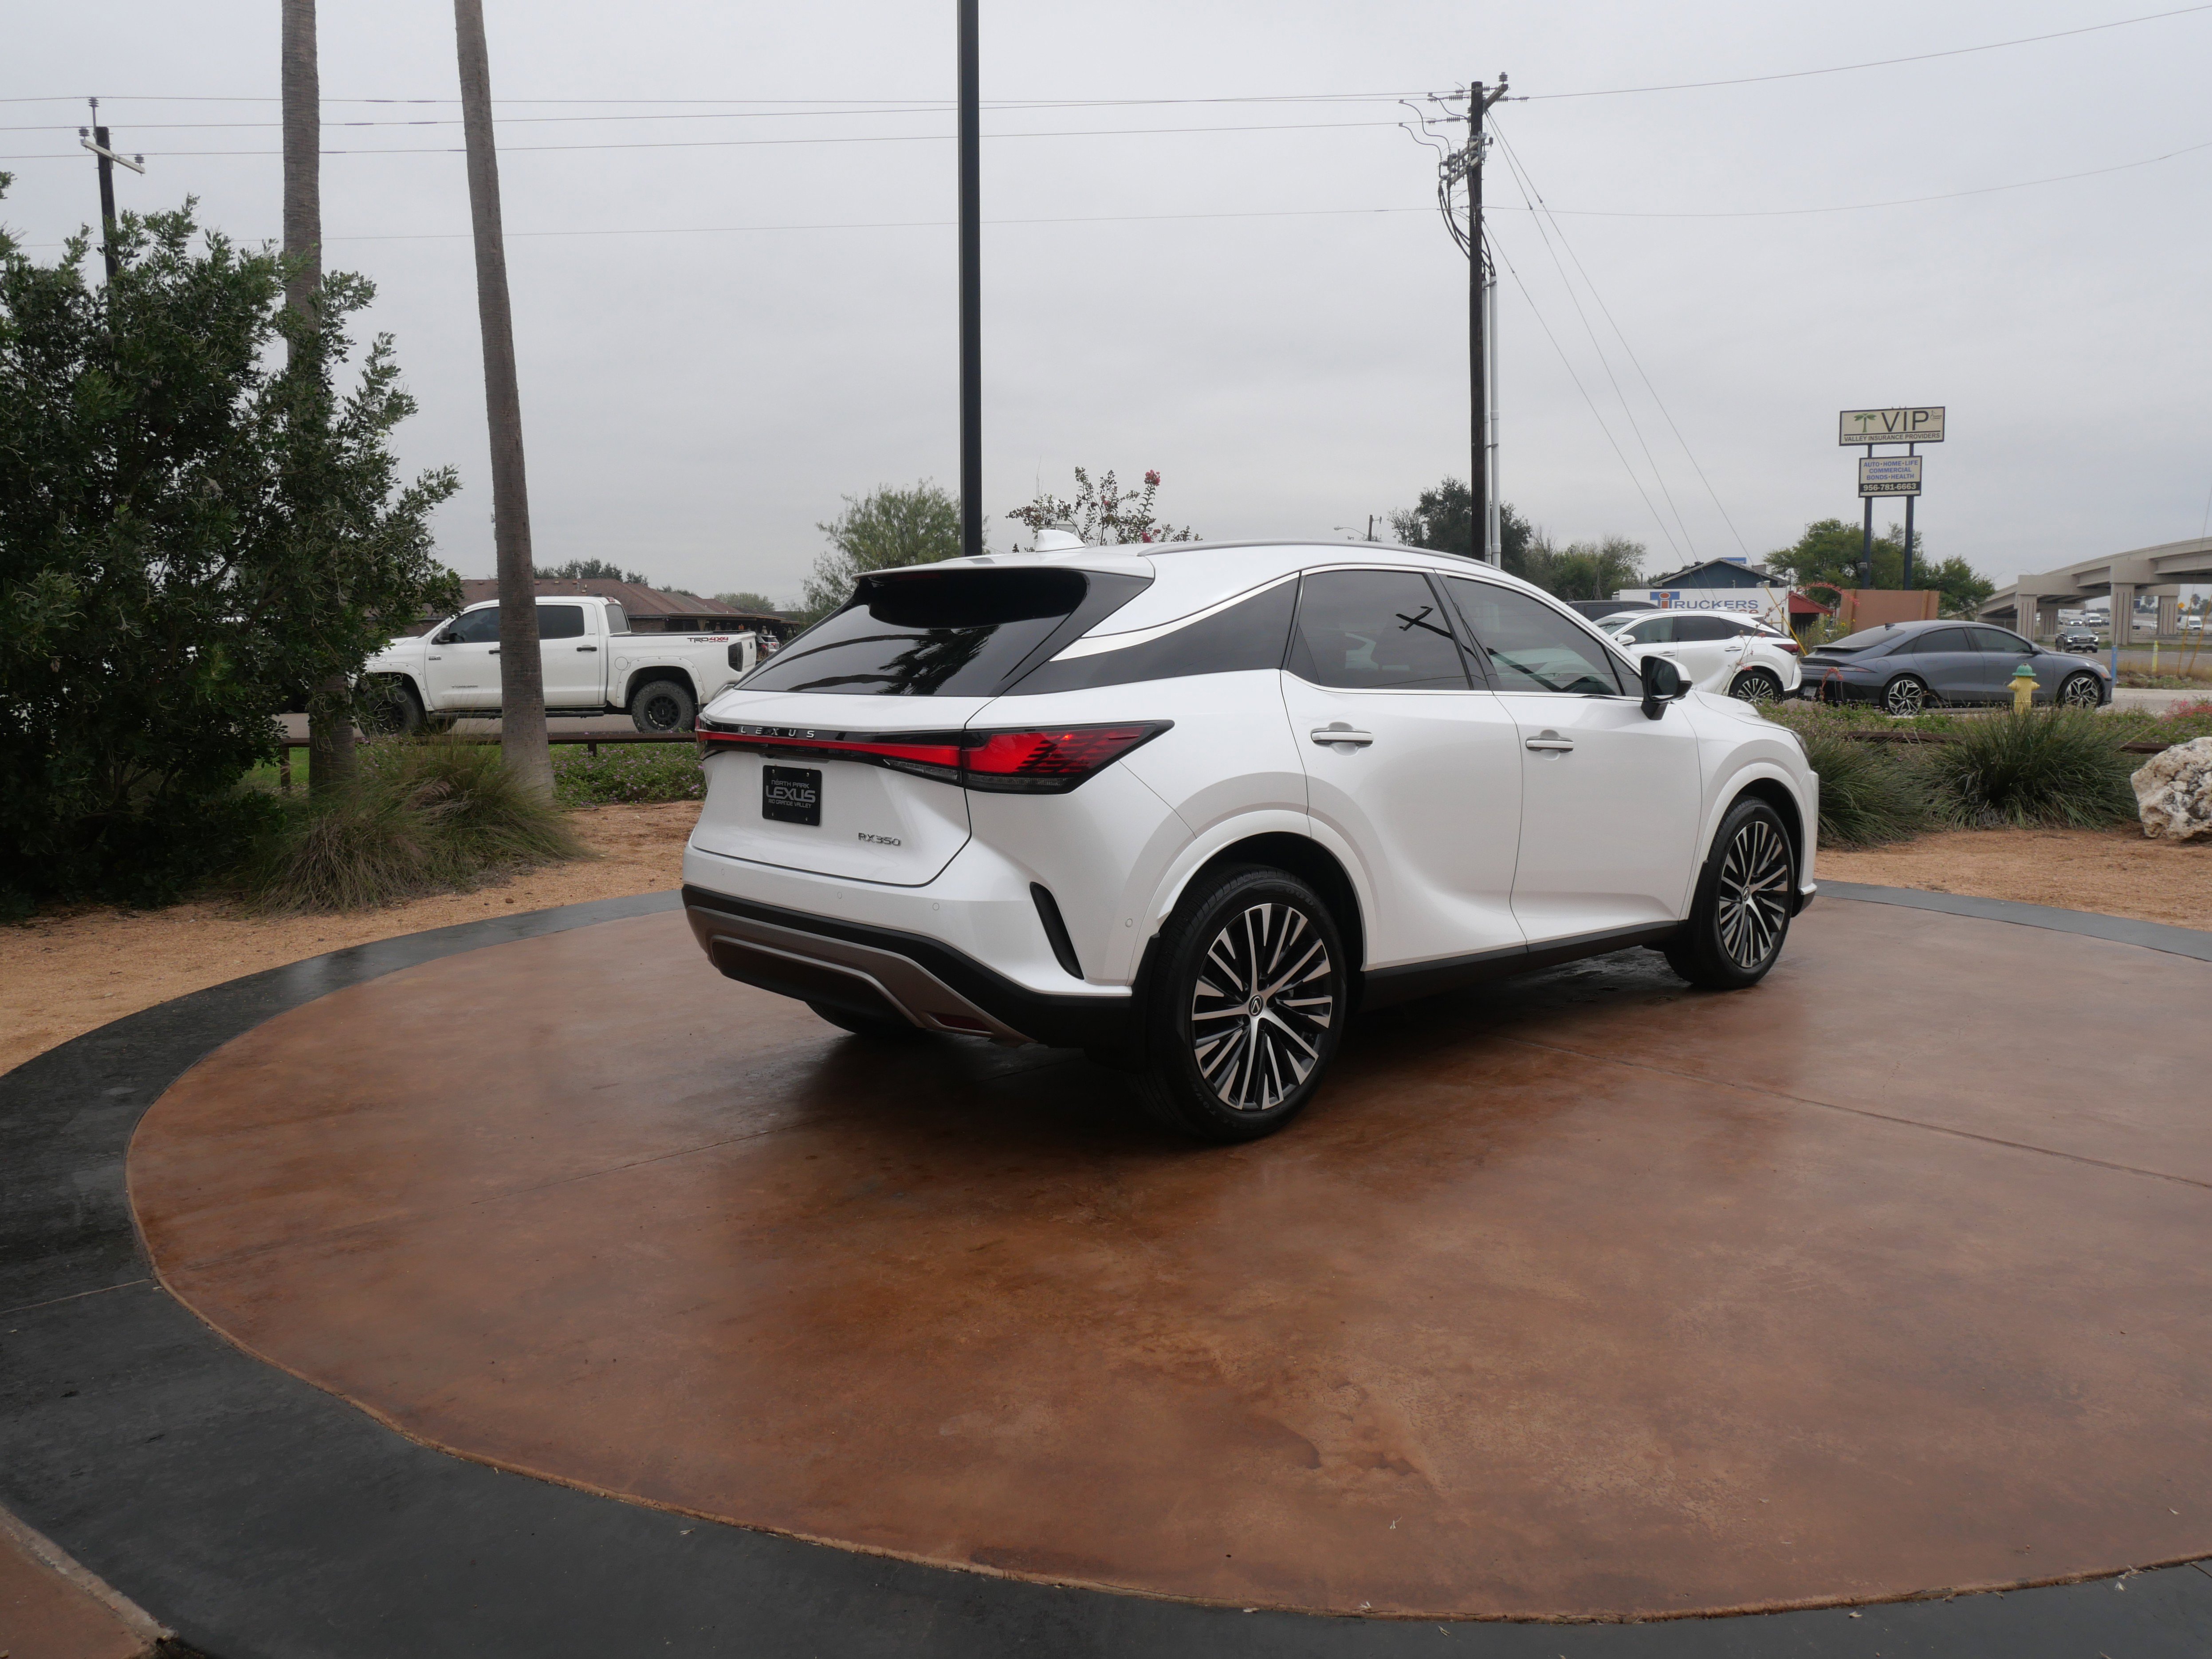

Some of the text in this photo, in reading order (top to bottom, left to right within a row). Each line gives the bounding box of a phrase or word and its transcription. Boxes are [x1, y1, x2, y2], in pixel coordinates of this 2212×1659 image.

[1881, 410, 1929, 432] VIP
[1863, 483, 1917, 491] 956-781-6663
[740, 726, 815, 738] LEXUS
[766, 785, 816, 803] LEXUS
